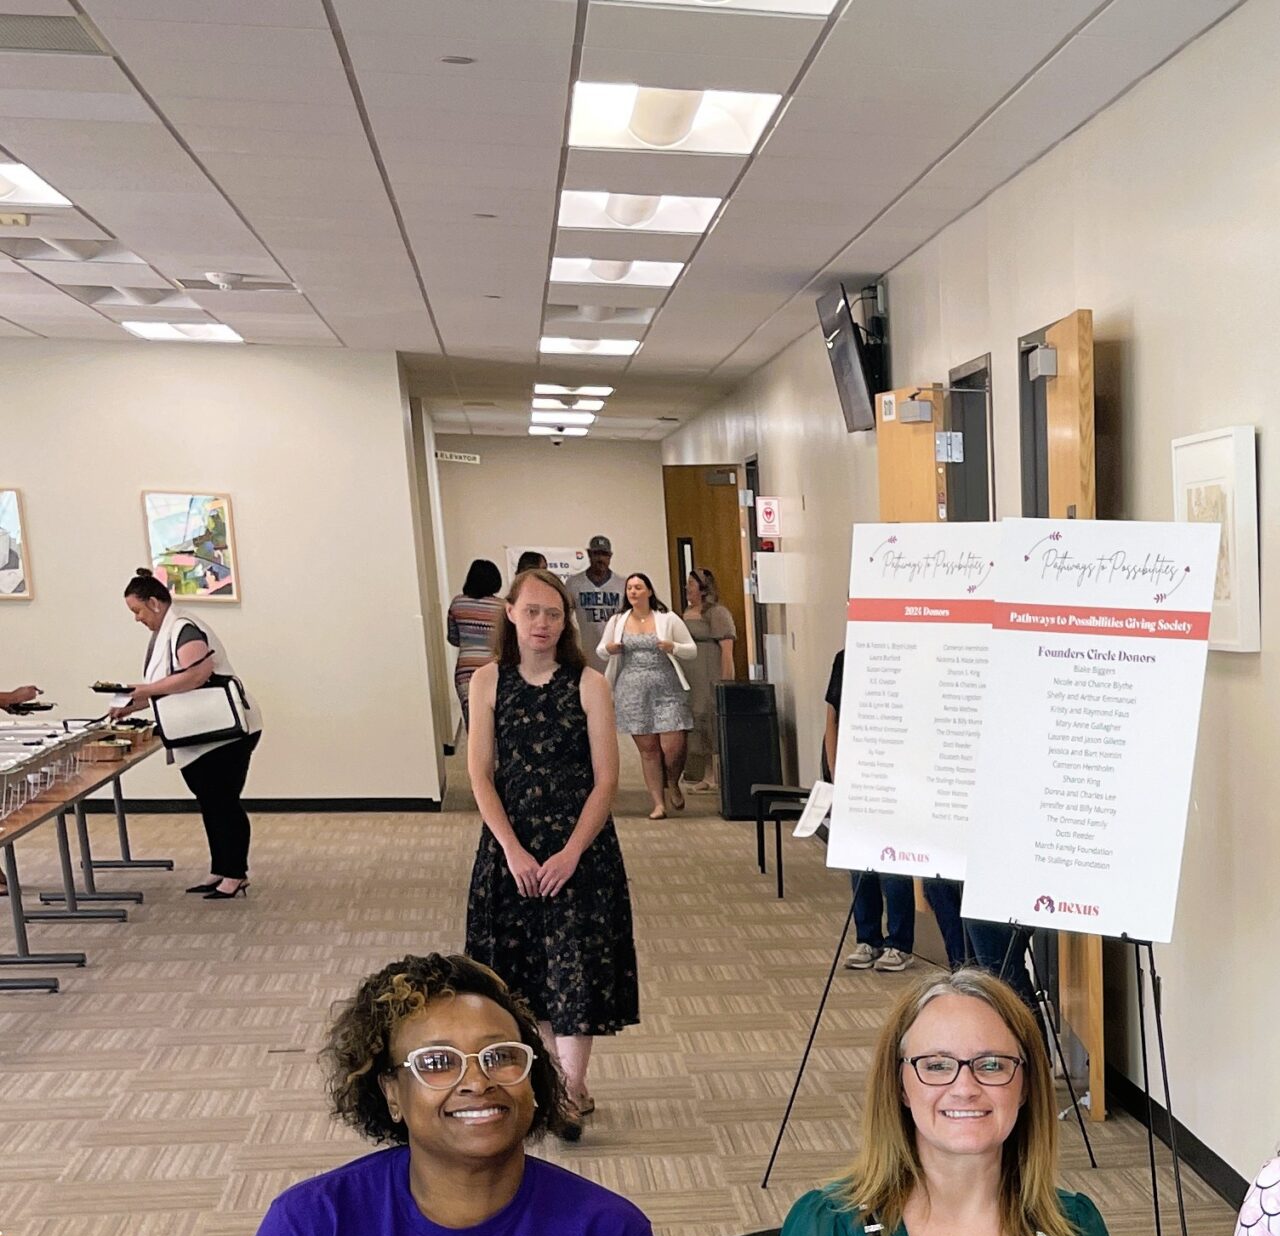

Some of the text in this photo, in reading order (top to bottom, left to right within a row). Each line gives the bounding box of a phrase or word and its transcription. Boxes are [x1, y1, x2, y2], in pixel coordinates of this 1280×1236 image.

[440, 452, 477, 461] ELEVATOR
[1041, 548, 1096, 586] Pathways
[1109, 551, 1178, 584] Possibilities
[579, 592, 620, 606] DREAM
[923, 606, 949, 616] Donors
[1010, 612, 1193, 634] Pathways to Possibilities Giving Society
[1038, 645, 1156, 663] Founders Circle Donors
[1053, 677, 1133, 691] Nicole and Chance Blythe
[1047, 691, 1065, 700] Shelly
[1080, 693, 1100, 702] Arthur
[1102, 695, 1136, 705] Emmanuel
[1083, 707, 1113, 717] Raymond
[1056, 719, 1121, 732] Mary Anne Gallagher
[1048, 733, 1070, 741] Lauren
[1084, 735, 1101, 744] Jason
[1048, 747, 1069, 756] Jessica
[1071, 748, 1083, 756] and
[1053, 760, 1081, 769] Cameron
[1063, 775, 1101, 787] Sharon King
[1044, 787, 1116, 801] Donna and Charles Lee
[1040, 800, 1117, 816] Jennifer and Billy Murray
[1047, 815, 1058, 823] The
[1088, 819, 1107, 829] Family
[1035, 841, 1114, 856] March Family Foundation
[898, 851, 930, 863] nexus
[1034, 854, 1110, 870] The Stallings Foundation
[1058, 901, 1100, 916] nexus
